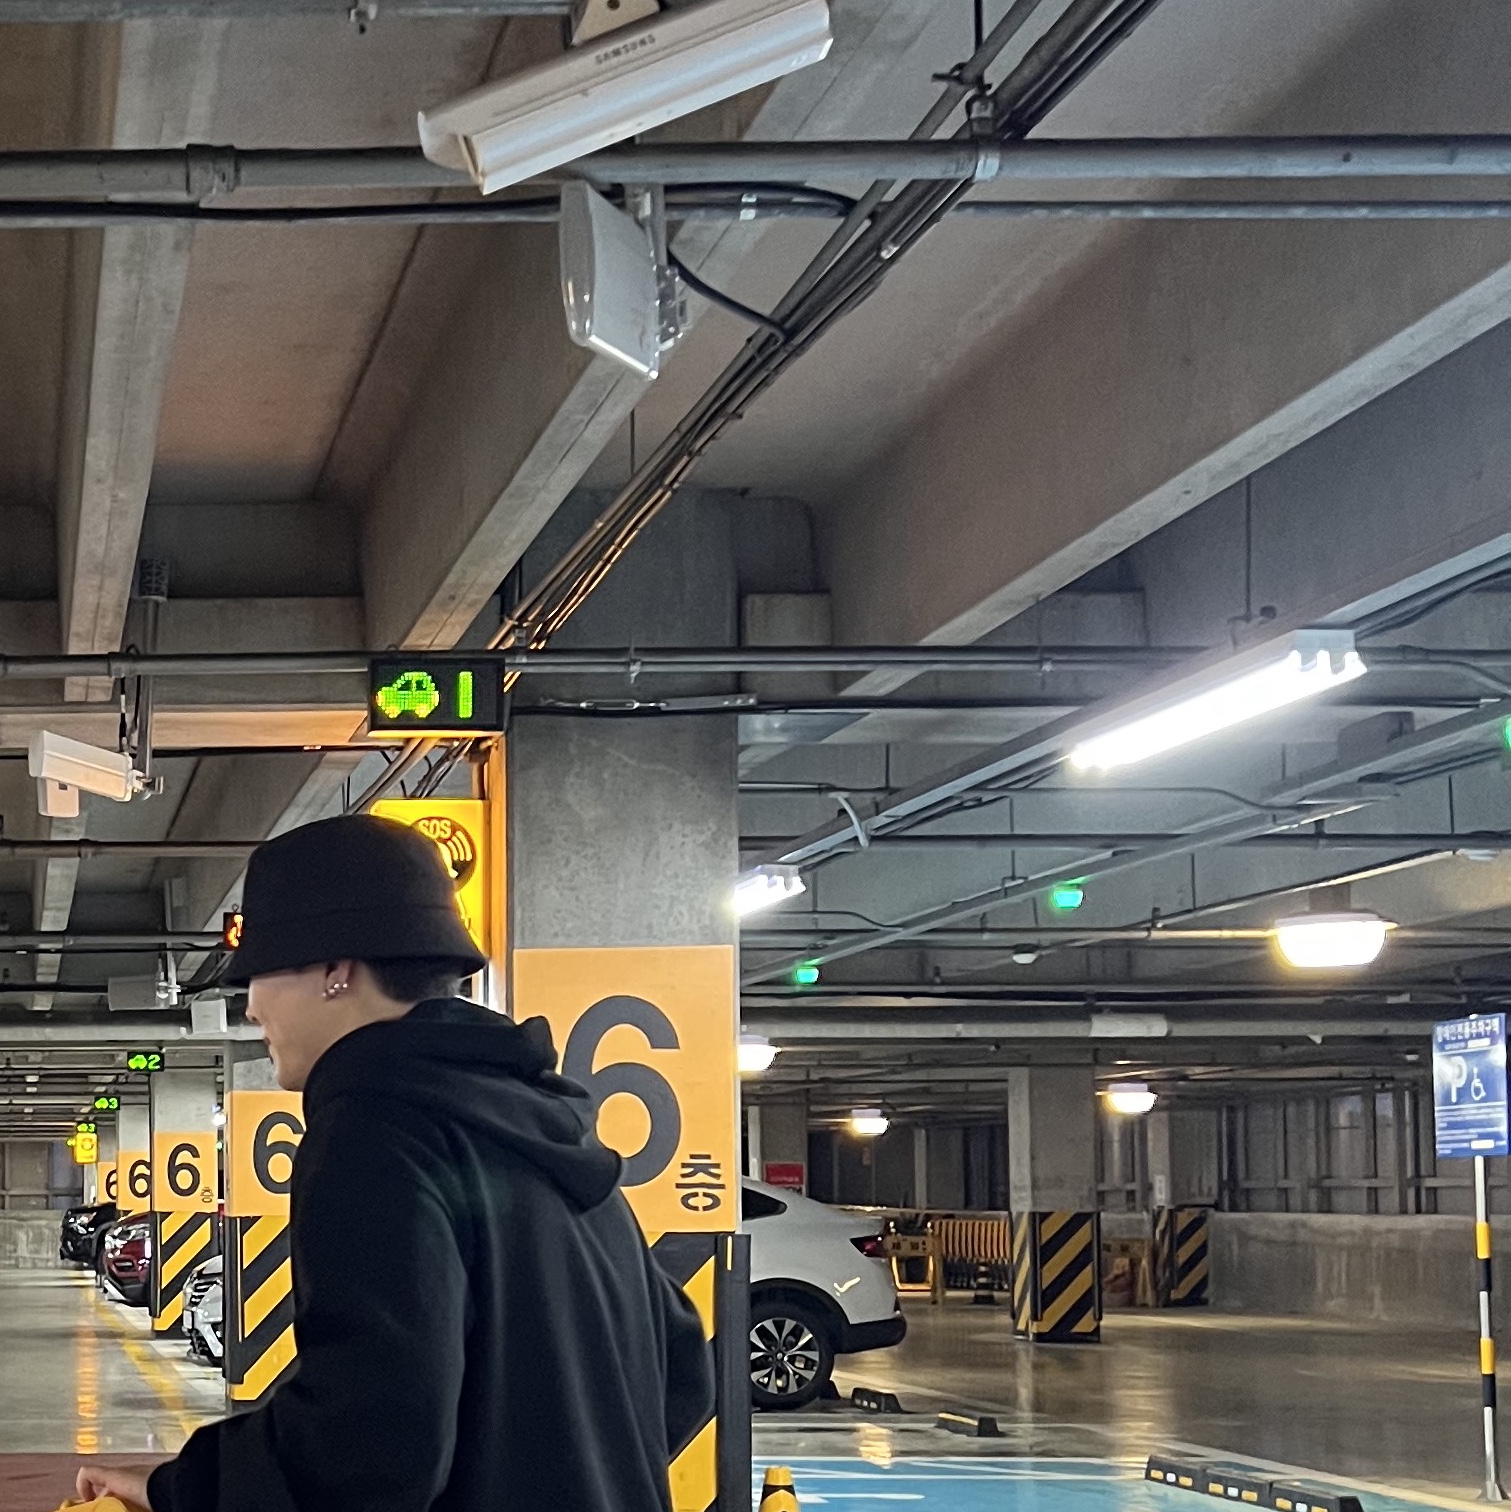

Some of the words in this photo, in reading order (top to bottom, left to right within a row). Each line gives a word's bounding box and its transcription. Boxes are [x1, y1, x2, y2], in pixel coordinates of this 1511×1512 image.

[418, 819, 452, 840] SOS
[148, 1054, 161, 1070] 2
[108, 1098, 118, 1109] 3
[253, 1112, 307, 1194] 6
[129, 1159, 152, 1198] 6
